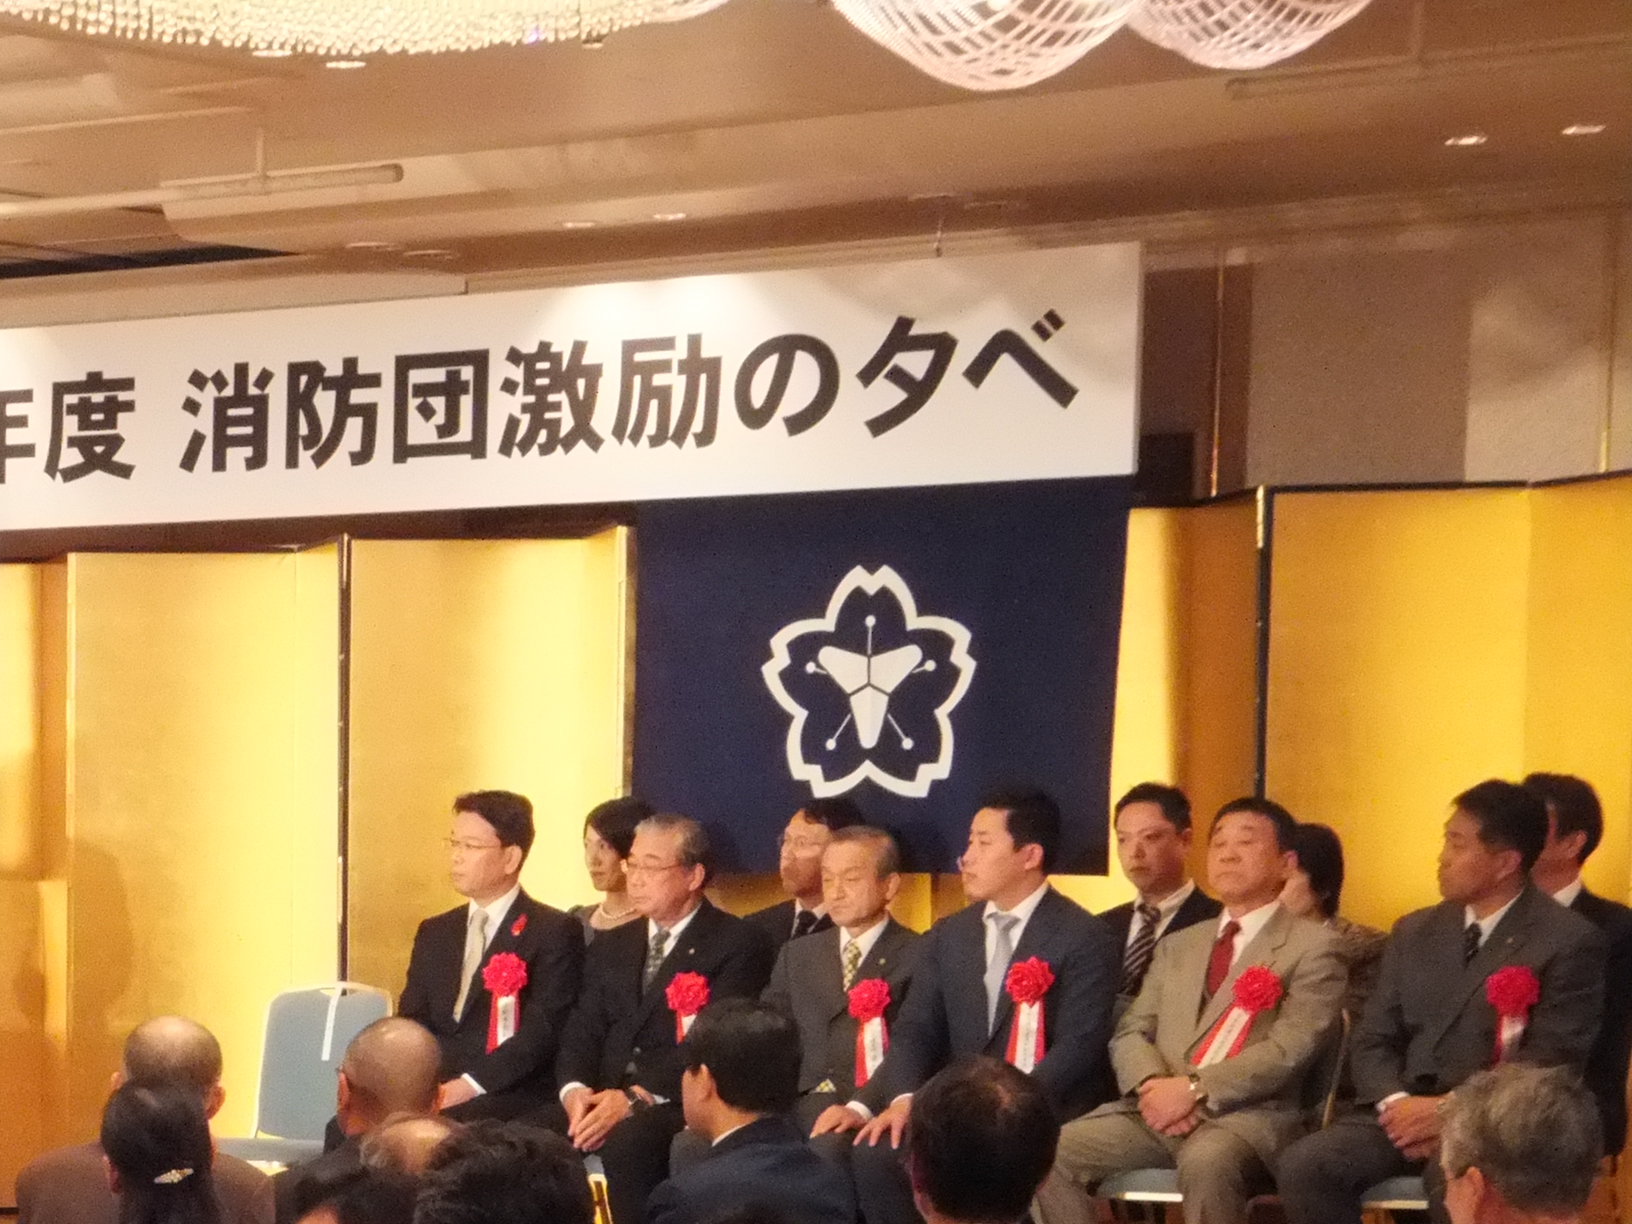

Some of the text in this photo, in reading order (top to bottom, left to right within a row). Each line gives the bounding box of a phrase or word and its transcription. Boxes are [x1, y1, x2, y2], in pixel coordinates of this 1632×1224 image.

[179, 308, 1080, 473] 消防団激励の夕べ
